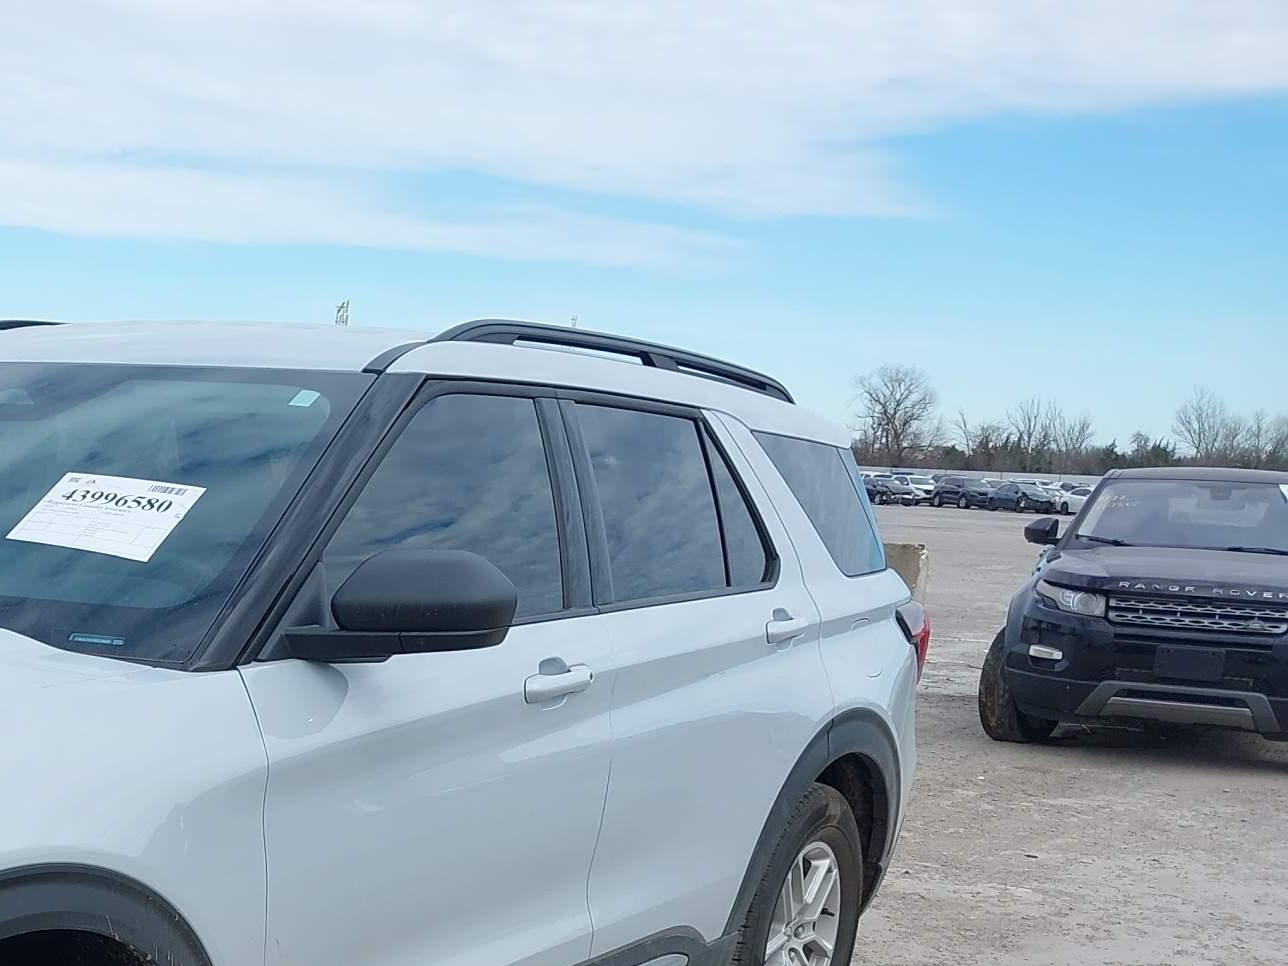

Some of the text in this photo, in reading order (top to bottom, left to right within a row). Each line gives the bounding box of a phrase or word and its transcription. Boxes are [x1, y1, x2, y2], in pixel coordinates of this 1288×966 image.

[61, 487, 173, 514] 43996580
[1118, 581, 1288, 599] RANGE ROVER
